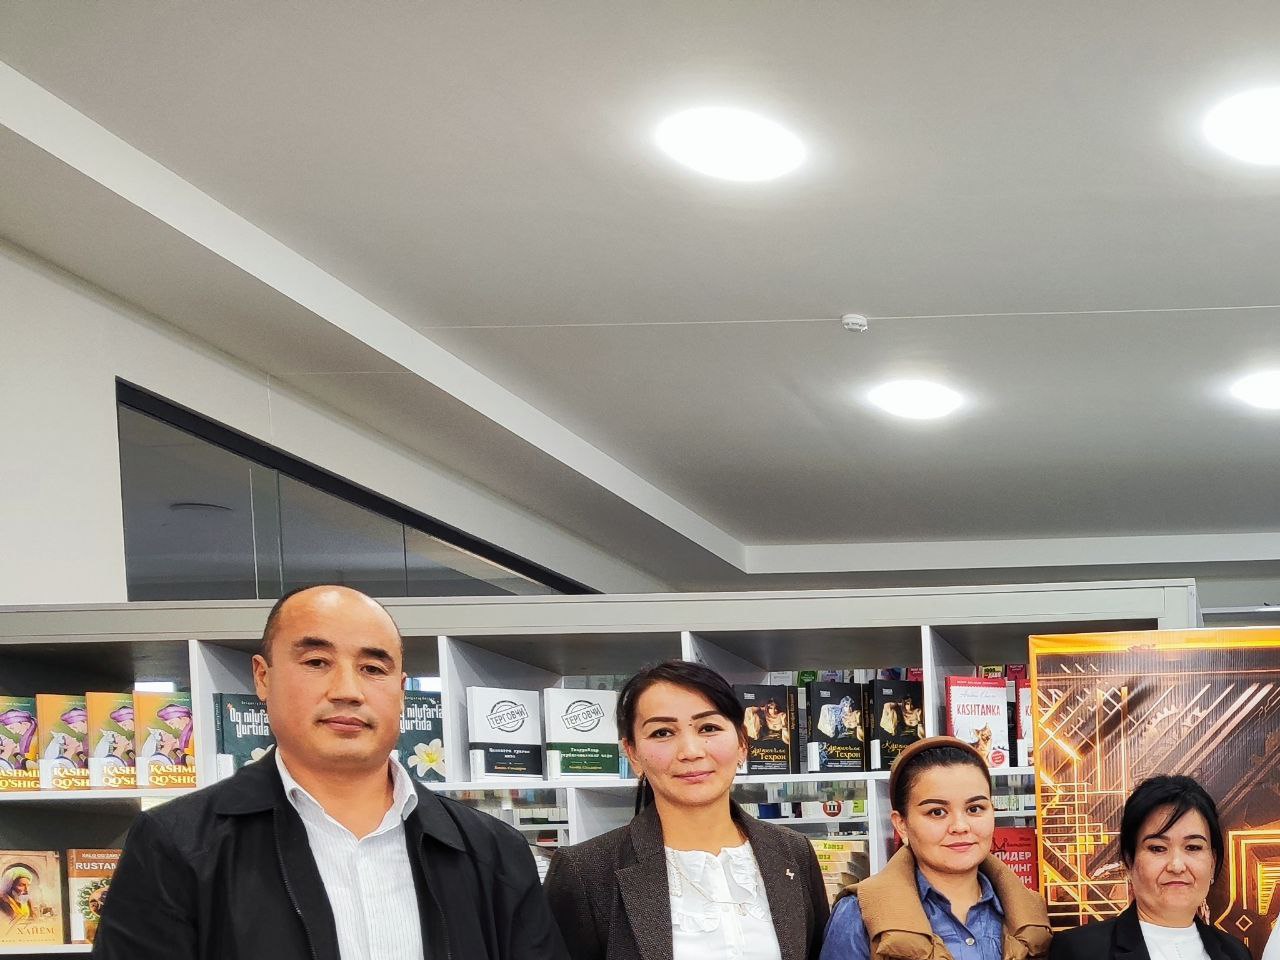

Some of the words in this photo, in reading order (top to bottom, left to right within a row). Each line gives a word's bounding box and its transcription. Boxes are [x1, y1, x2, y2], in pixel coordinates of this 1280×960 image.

[956, 703, 1001, 716] KASHTANKA
[490, 708, 526, 727] ТЕРГОВЧИ
[565, 707, 602, 726] ТЕРГОВЧИ
[0, 769, 40, 778] ASHMI
[0, 778, 40, 789] O'SHIG
[823, 842, 844, 850] Xamsa
